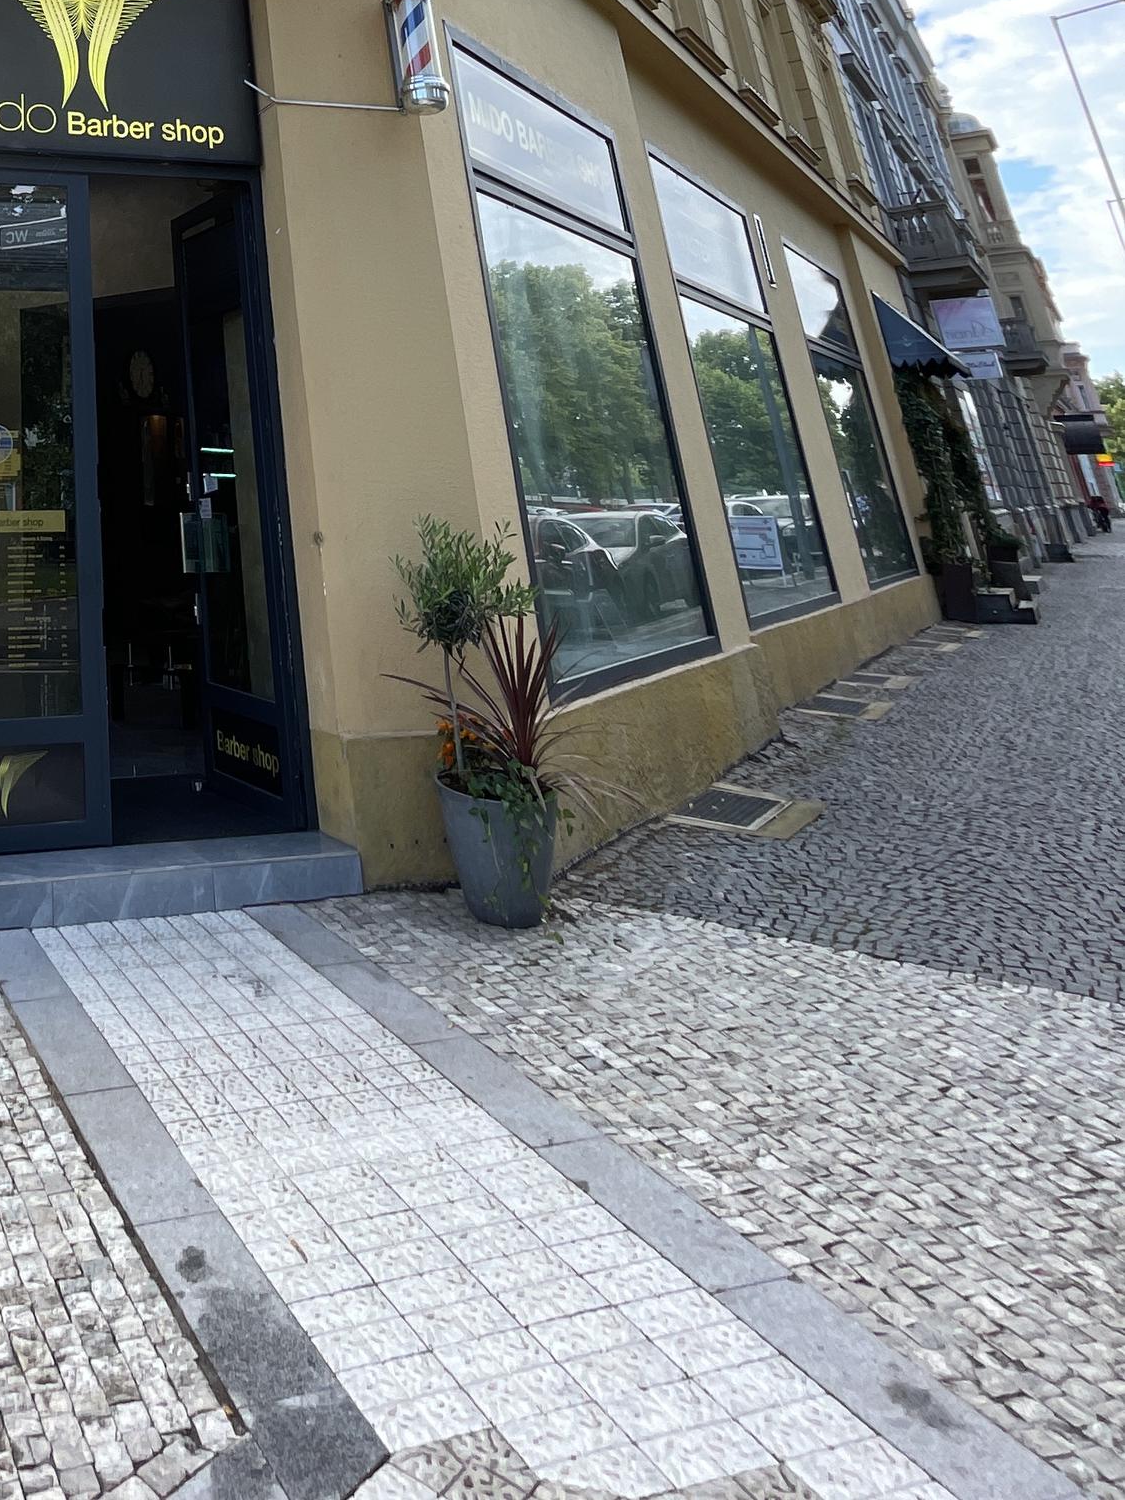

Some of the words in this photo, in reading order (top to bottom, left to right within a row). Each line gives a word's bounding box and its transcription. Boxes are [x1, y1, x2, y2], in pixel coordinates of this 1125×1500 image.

[67, 110, 155, 140] Barber
[161, 118, 225, 149] shop
[515, 118, 575, 174] BARB
[216, 729, 251, 762] Barber
[252, 743, 279, 778] shop
